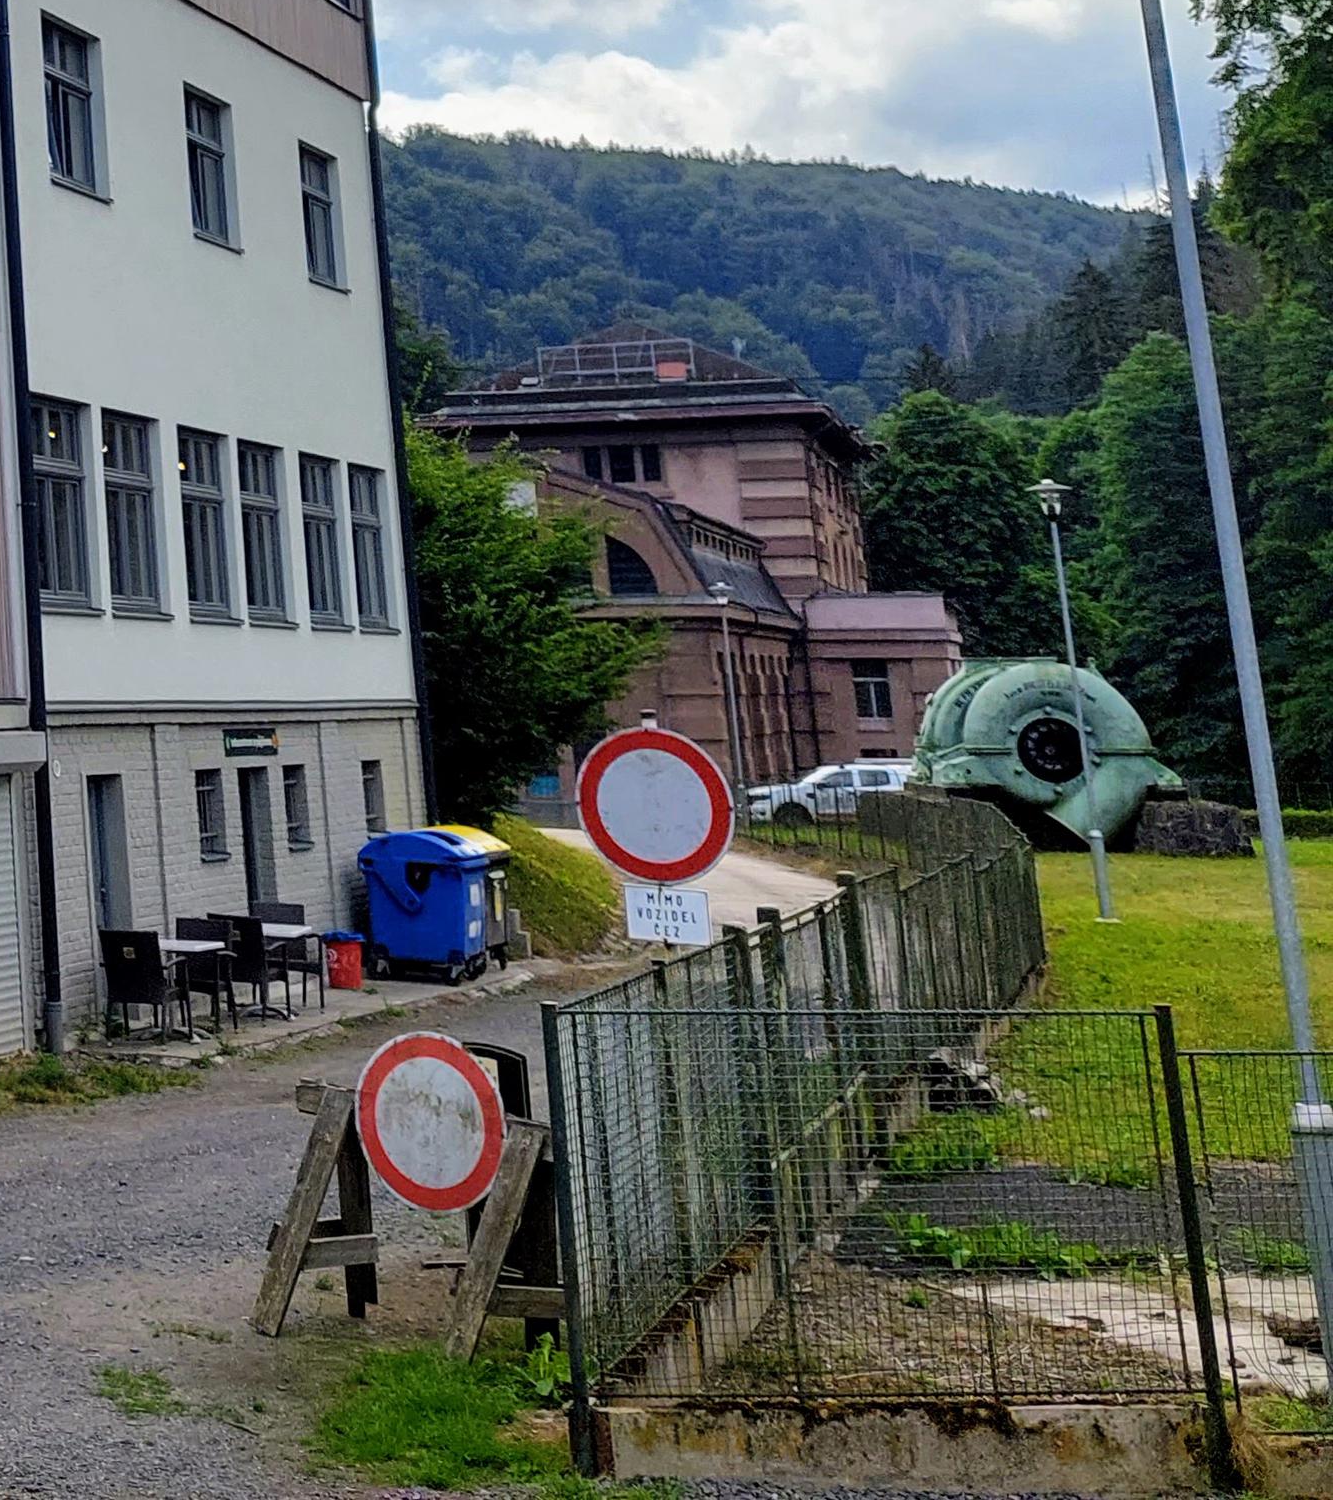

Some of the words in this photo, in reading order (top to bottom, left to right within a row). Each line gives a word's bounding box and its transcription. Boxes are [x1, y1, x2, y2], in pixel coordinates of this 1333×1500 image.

[646, 892, 683, 907] MIMO
[637, 907, 696, 924] VOZIDEL
[654, 923, 680, 938] ČEZ
